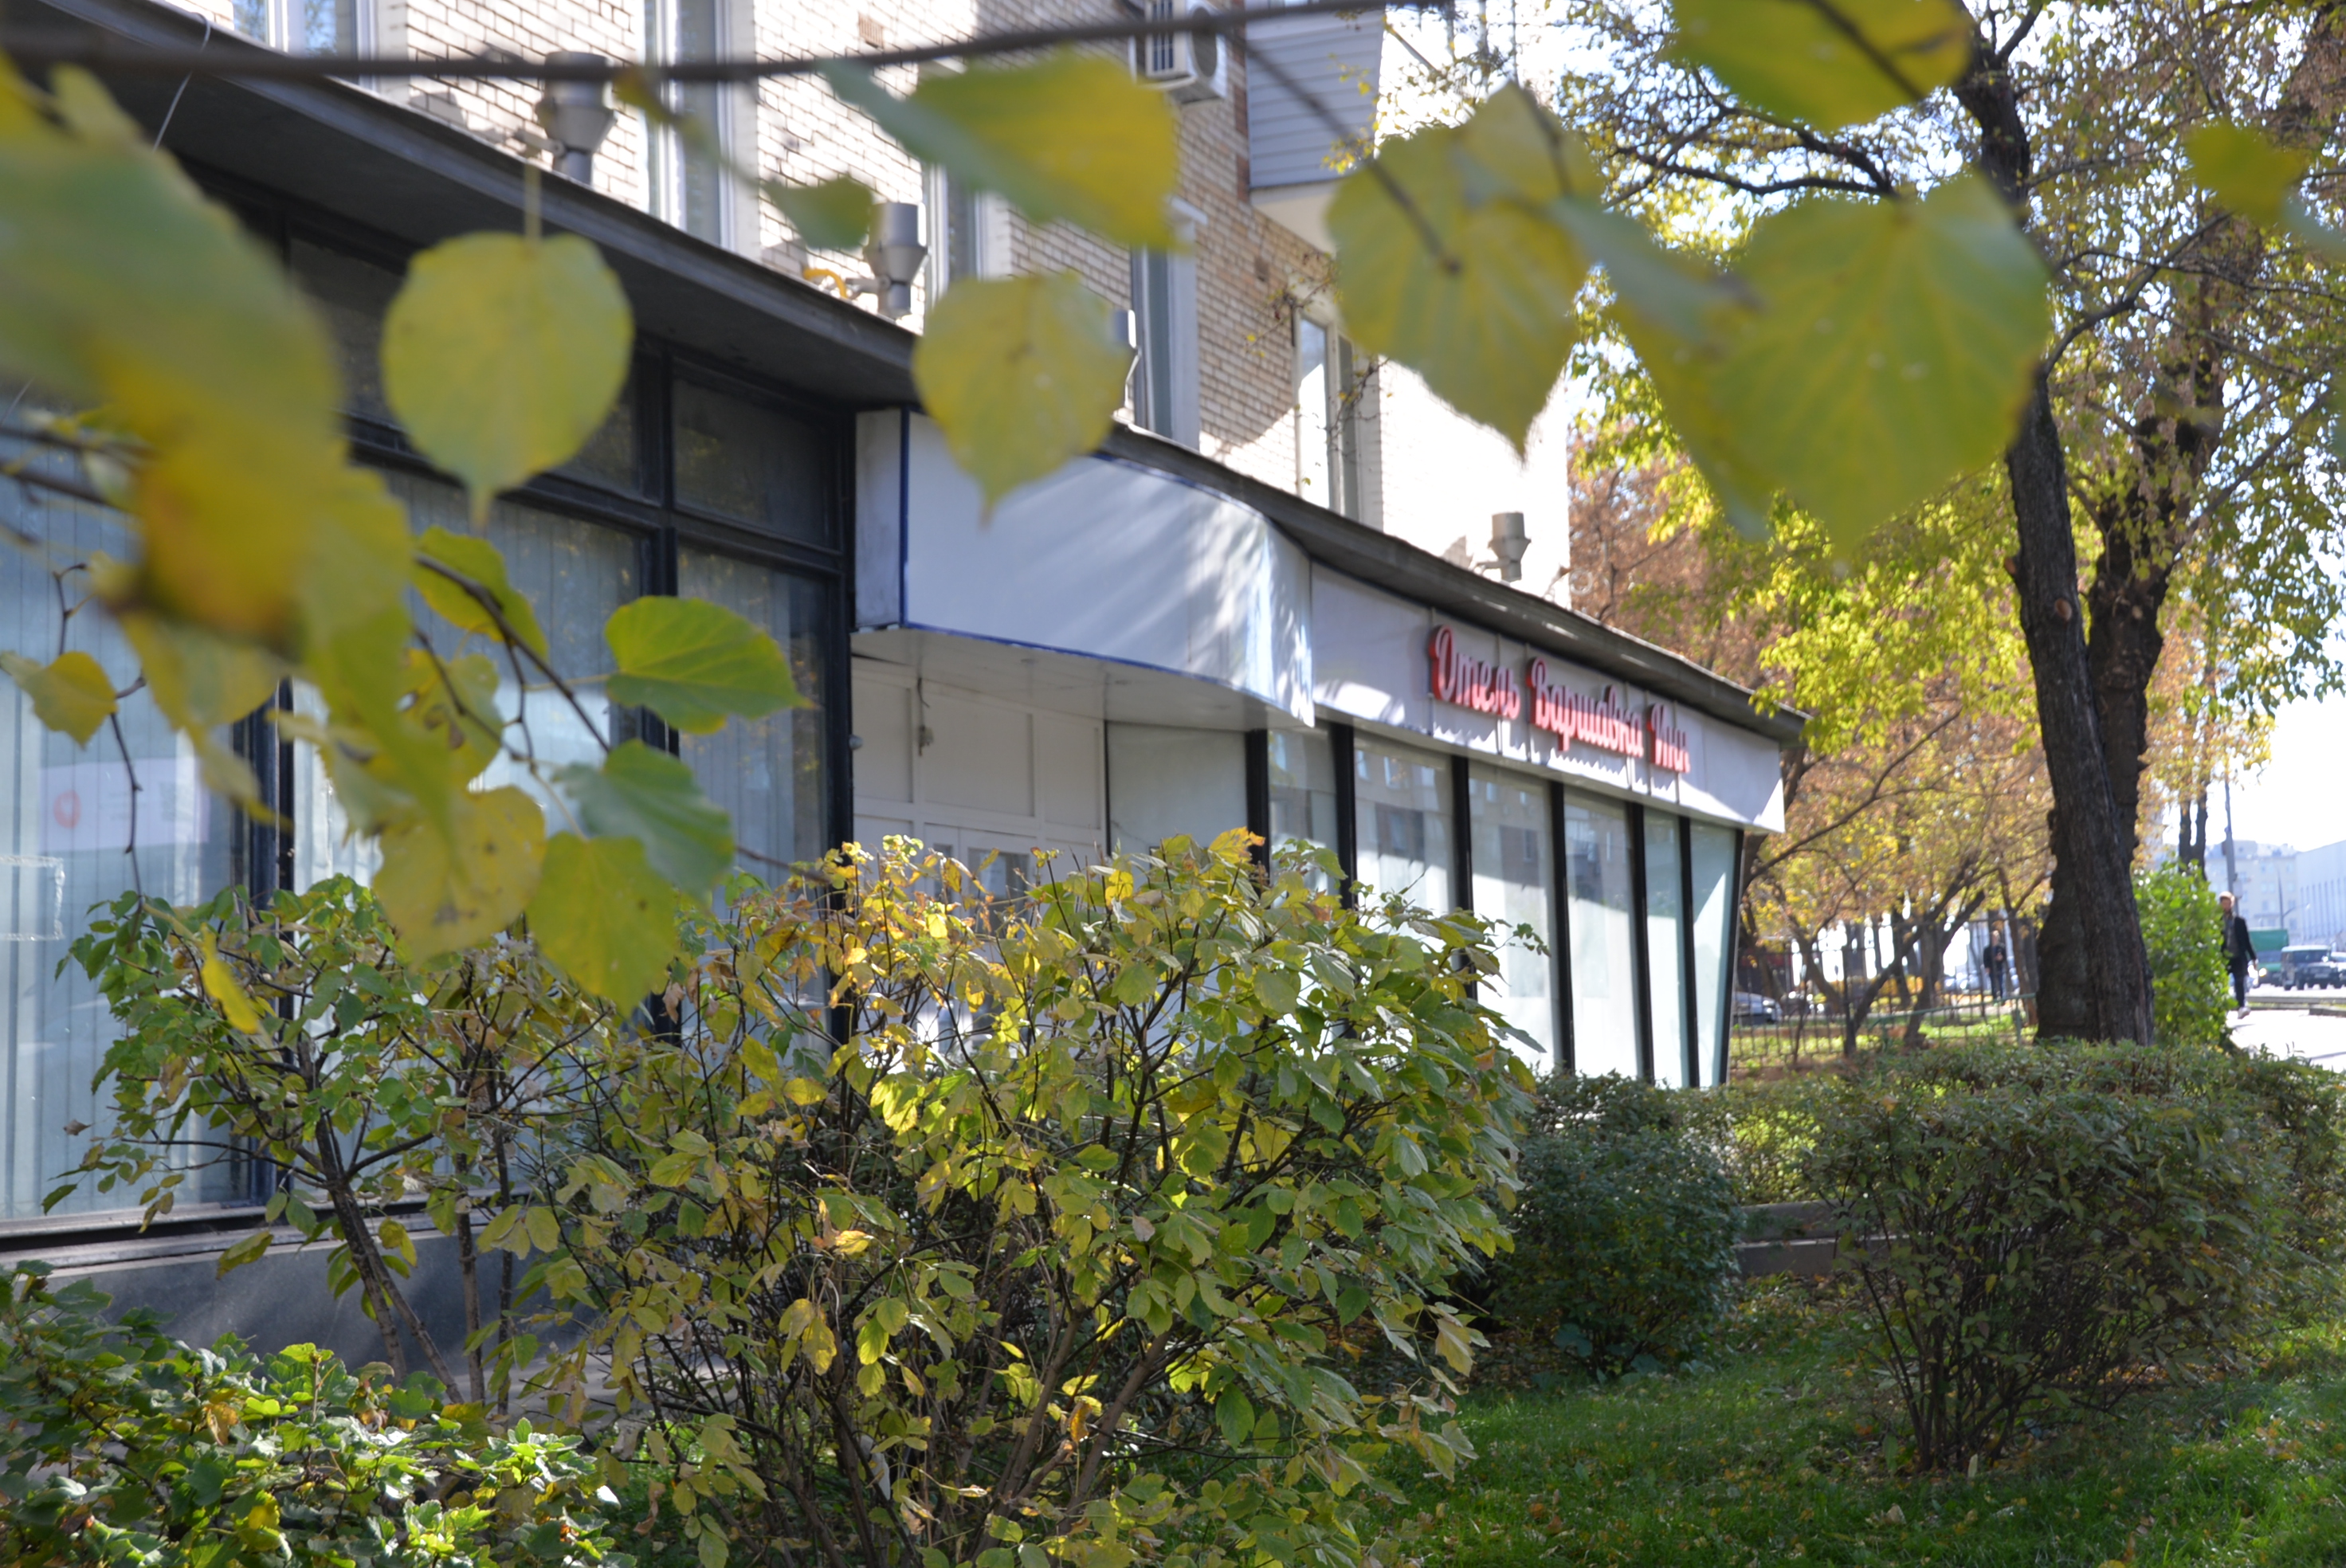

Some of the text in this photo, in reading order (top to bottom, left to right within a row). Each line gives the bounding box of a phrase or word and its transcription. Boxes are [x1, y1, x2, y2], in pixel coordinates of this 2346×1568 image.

[1429, 625, 1691, 774] Отель Варшавка Инн
